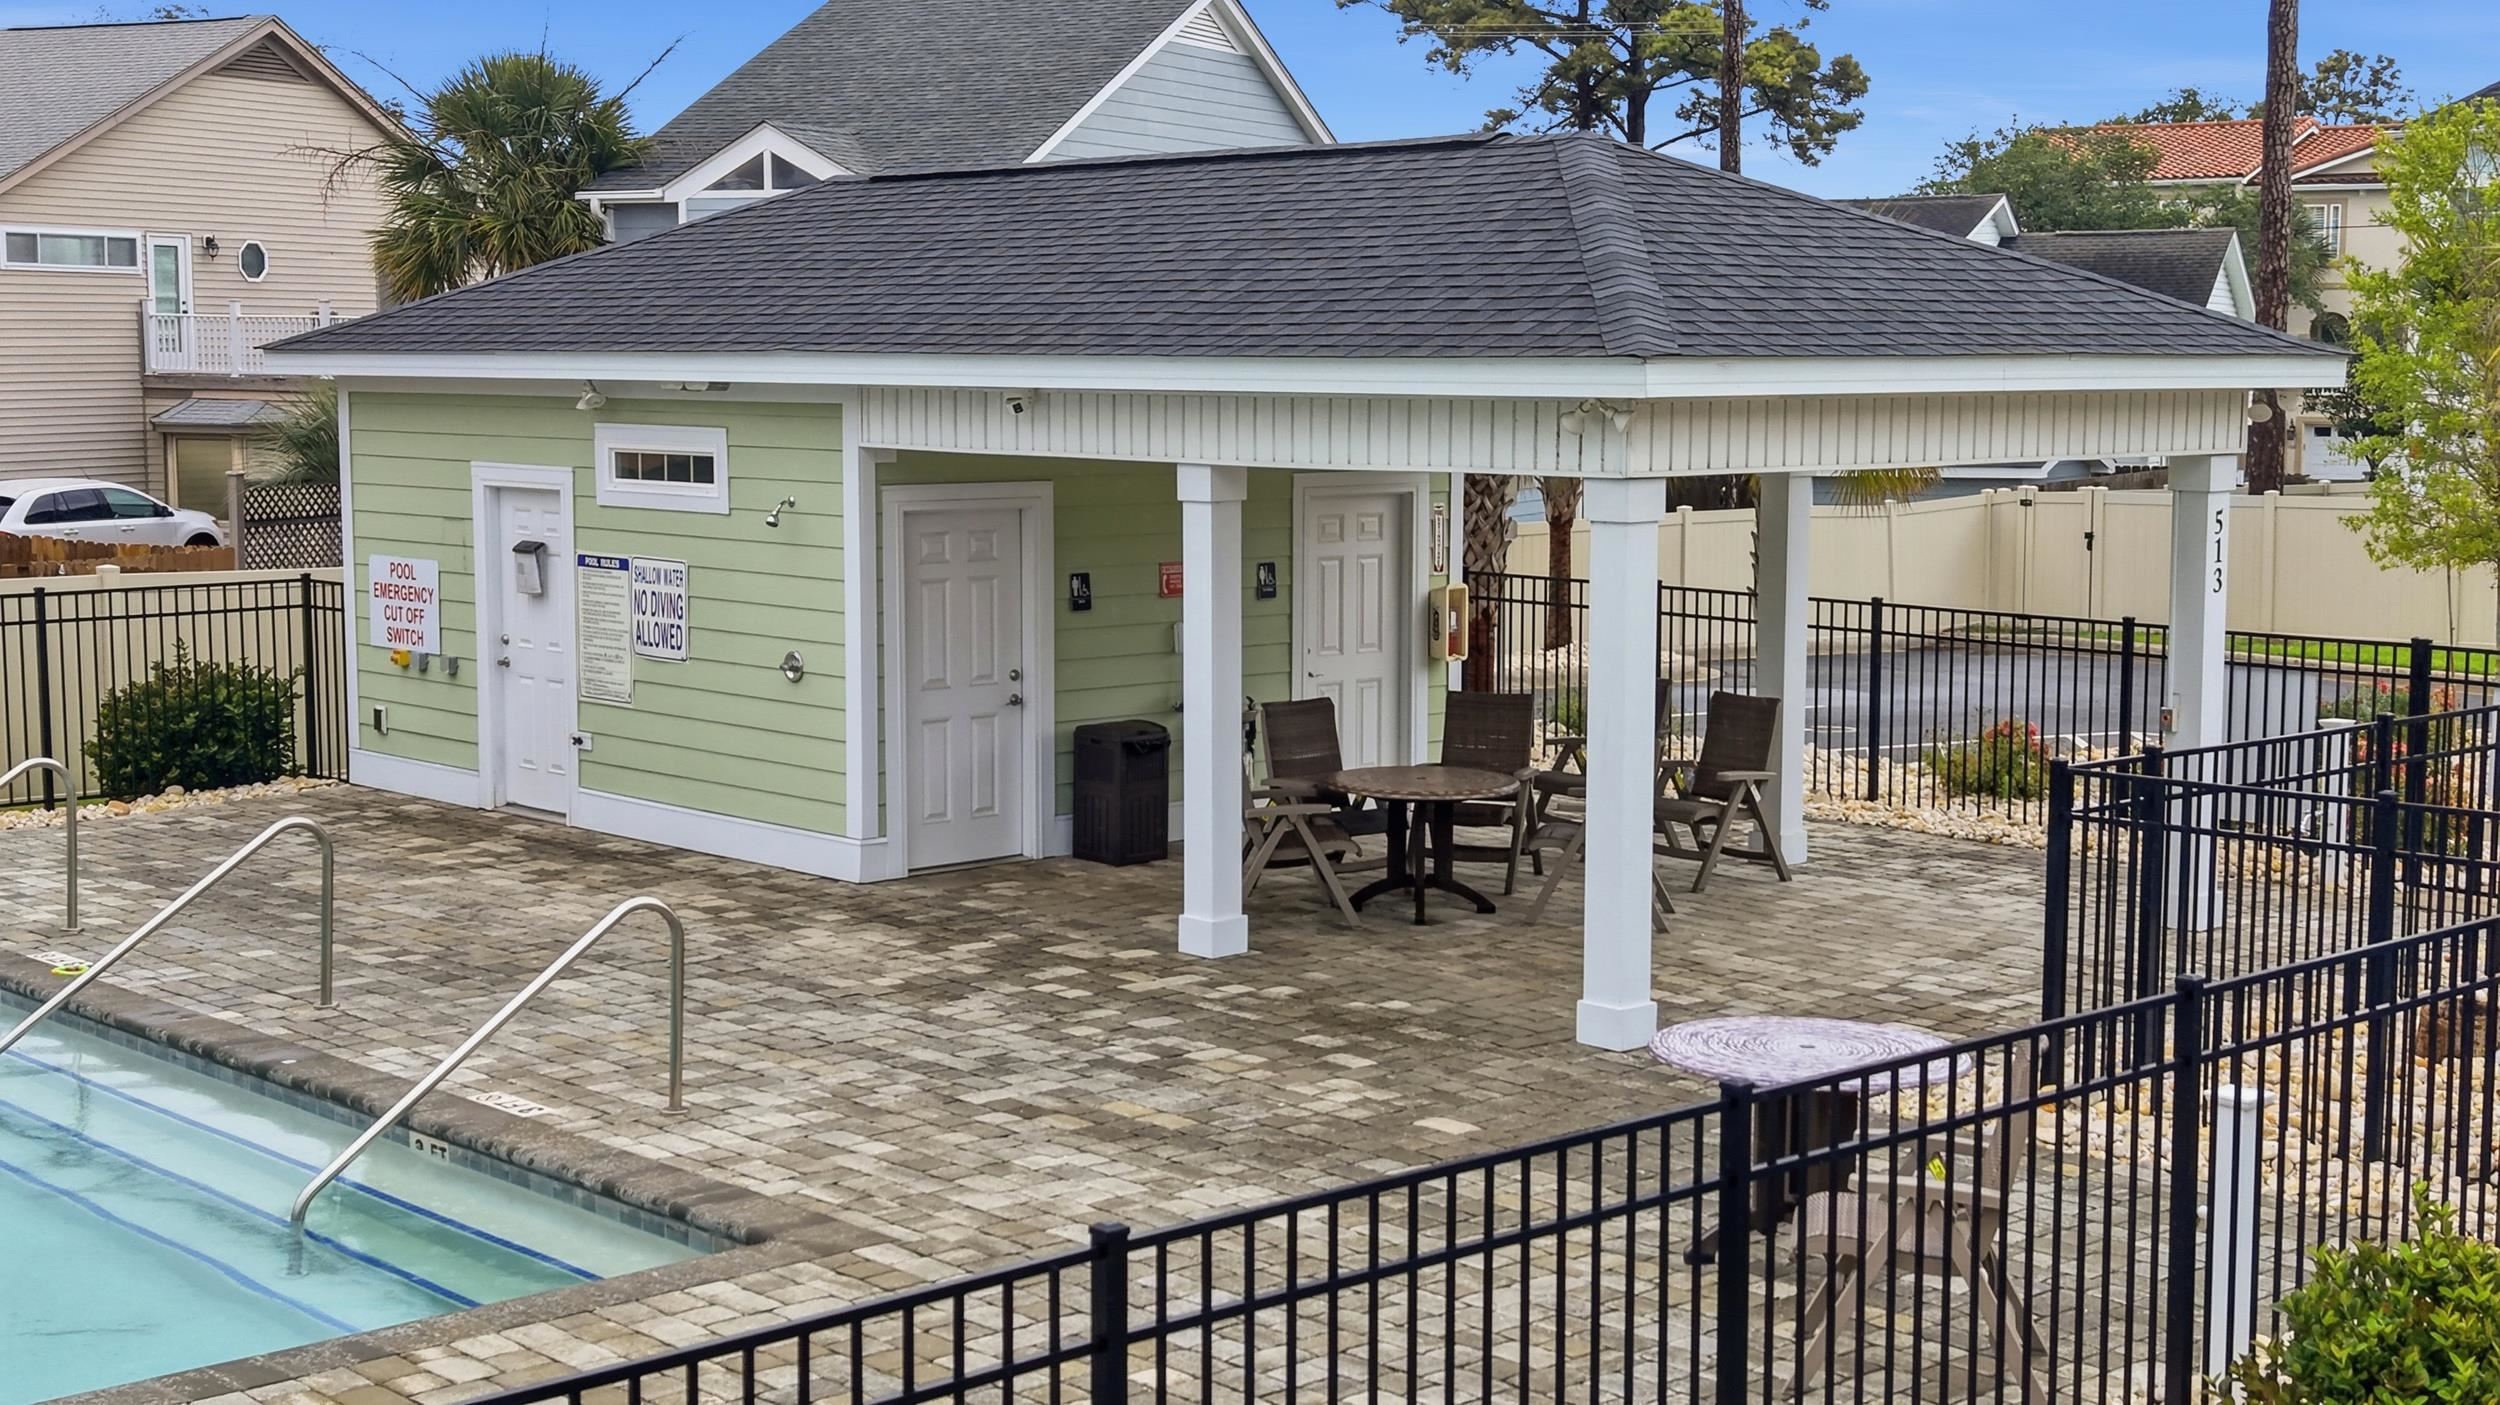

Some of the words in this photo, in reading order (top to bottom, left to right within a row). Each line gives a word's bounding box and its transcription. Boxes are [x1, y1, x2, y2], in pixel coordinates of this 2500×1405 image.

[2213, 508, 2223, 593] 513
[390, 562, 417, 580] POOL
[584, 556, 599, 567] POOL
[600, 558, 620, 569] RULES
[634, 565, 661, 585] SHALLOW
[663, 567, 684, 588] WATER
[373, 582, 434, 605] EMERGENCY
[633, 588, 648, 616] NO
[651, 590, 684, 620] DIVING
[384, 604, 403, 622] CUT
[406, 607, 425, 625] OFF
[386, 626, 424, 647] SWITCH
[635, 619, 683, 651] ALLOWED
[430, 1143, 447, 1159] FT
